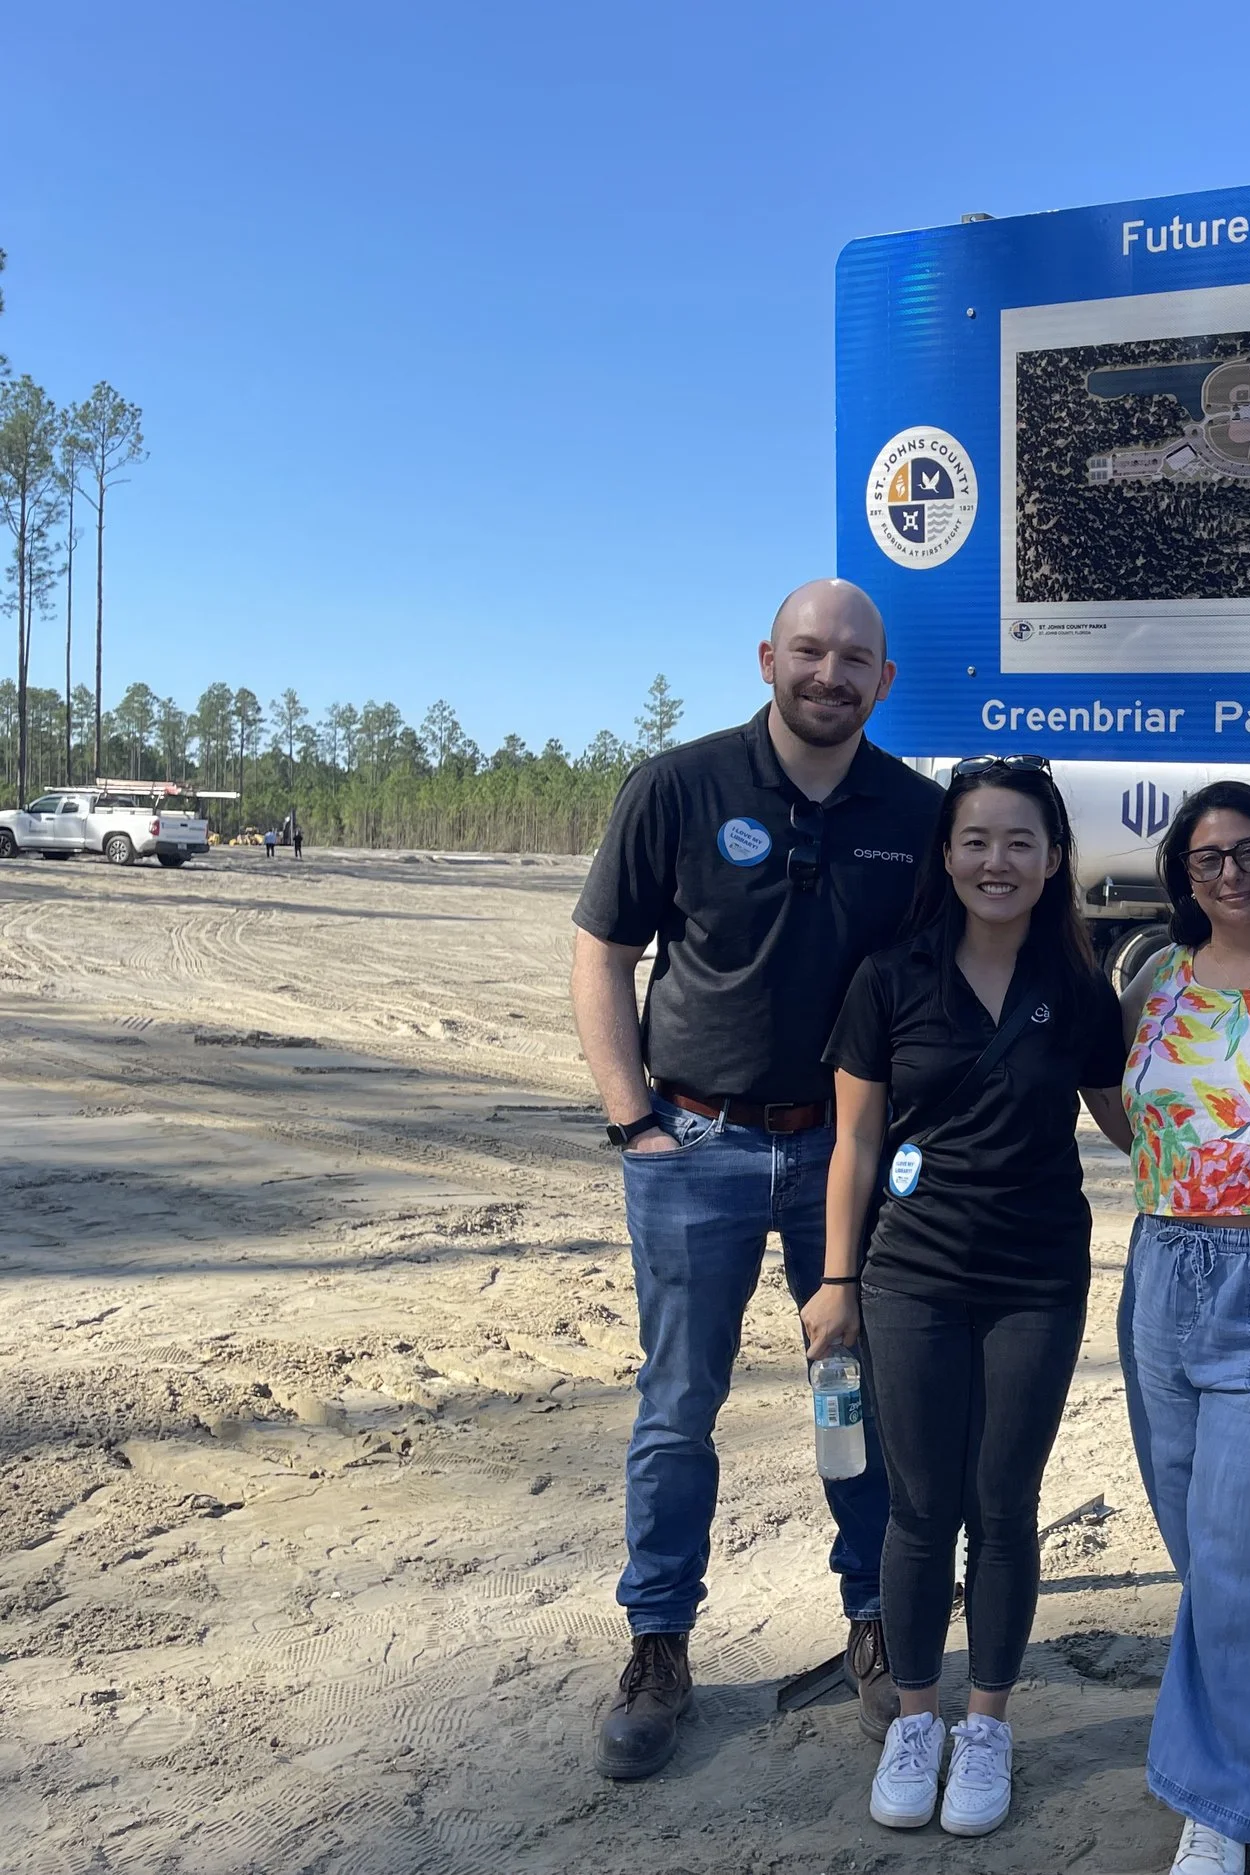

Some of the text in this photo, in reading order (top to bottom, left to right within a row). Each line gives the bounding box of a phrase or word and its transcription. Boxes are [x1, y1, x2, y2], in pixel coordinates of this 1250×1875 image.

[1122, 215, 1249, 256] Future
[874, 439, 969, 500] ST. JOHNS COUNTY
[881, 523, 906, 554] FLORIDA
[922, 544, 943, 557] FIRST
[944, 519, 962, 546] SIGHT
[982, 699, 1186, 733] Greenbriar
[736, 828, 752, 840] LOVE
[854, 848, 914, 864] OSPORTS
